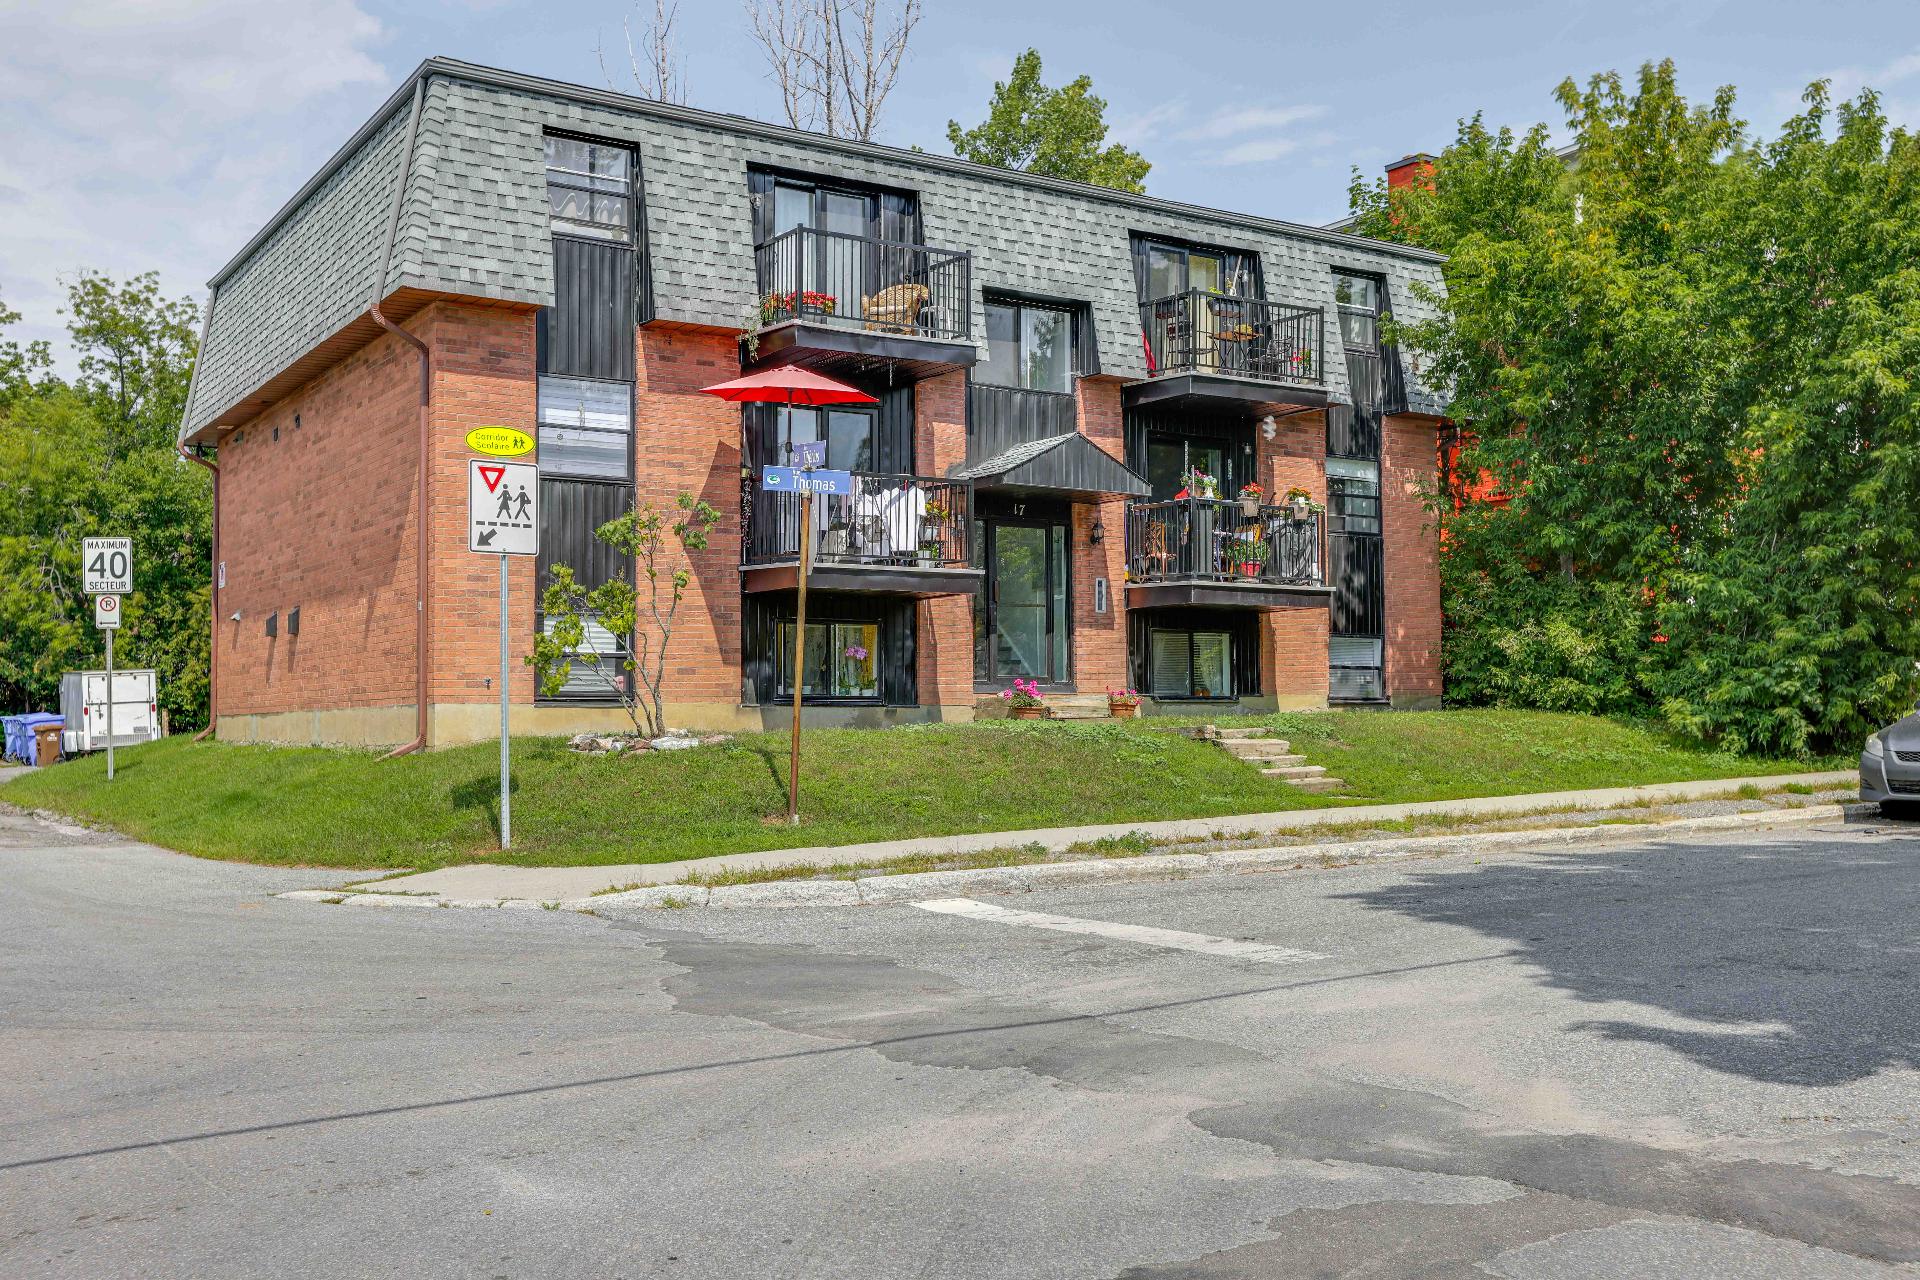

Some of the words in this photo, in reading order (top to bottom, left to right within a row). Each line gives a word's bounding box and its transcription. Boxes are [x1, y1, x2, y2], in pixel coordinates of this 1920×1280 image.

[475, 432, 509, 442] Corridor
[476, 441, 510, 450] Scolaire
[792, 475, 836, 491] Thomas
[87, 541, 127, 549] MAXIMUM
[88, 551, 127, 579] 40
[89, 581, 127, 590] SECTEUR
